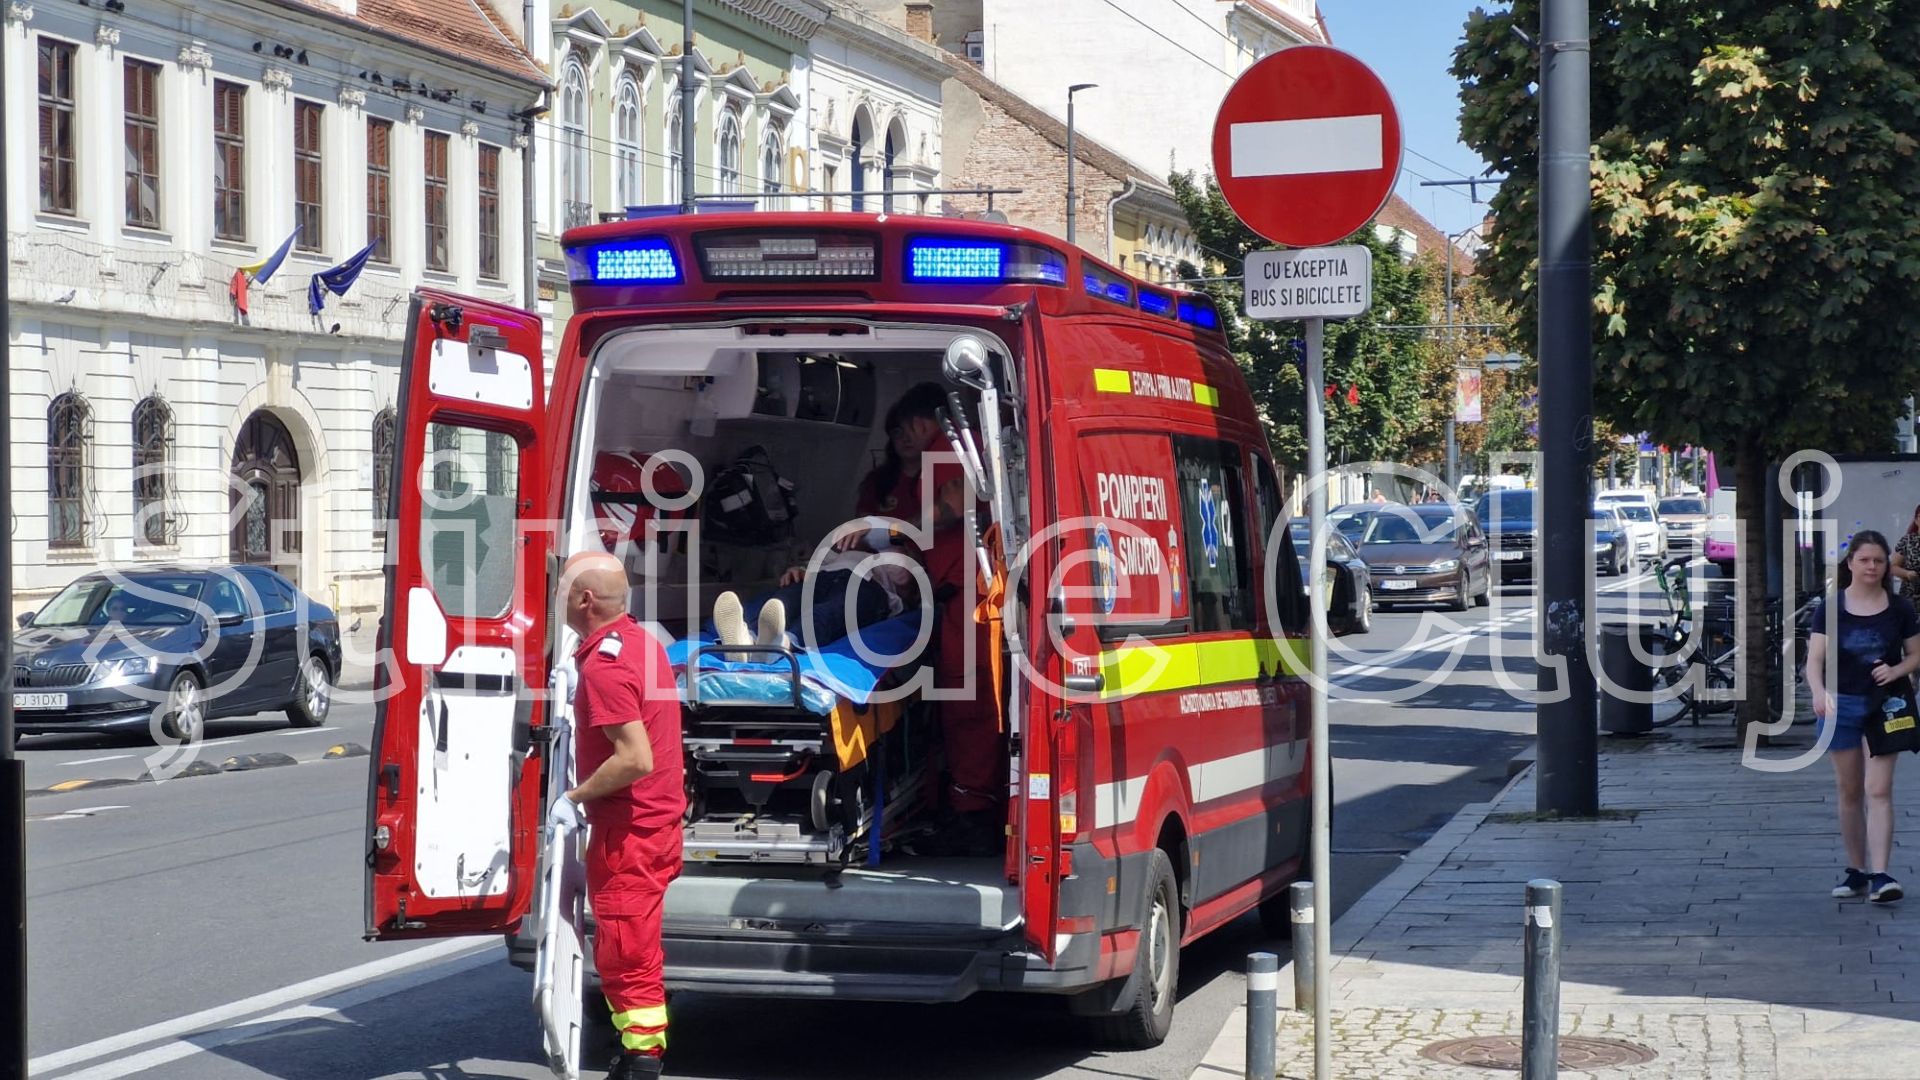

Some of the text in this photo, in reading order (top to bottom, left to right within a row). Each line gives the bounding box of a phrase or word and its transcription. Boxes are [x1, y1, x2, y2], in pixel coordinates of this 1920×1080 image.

[1263, 259, 1348, 280] CU EXCEPTIA
[1251, 285, 1362, 307] BUS SI BICICLETE
[1097, 473, 1168, 521] POMPIERII
[1119, 536, 1161, 576] SMURD
[14, 695, 27, 706] CJ
